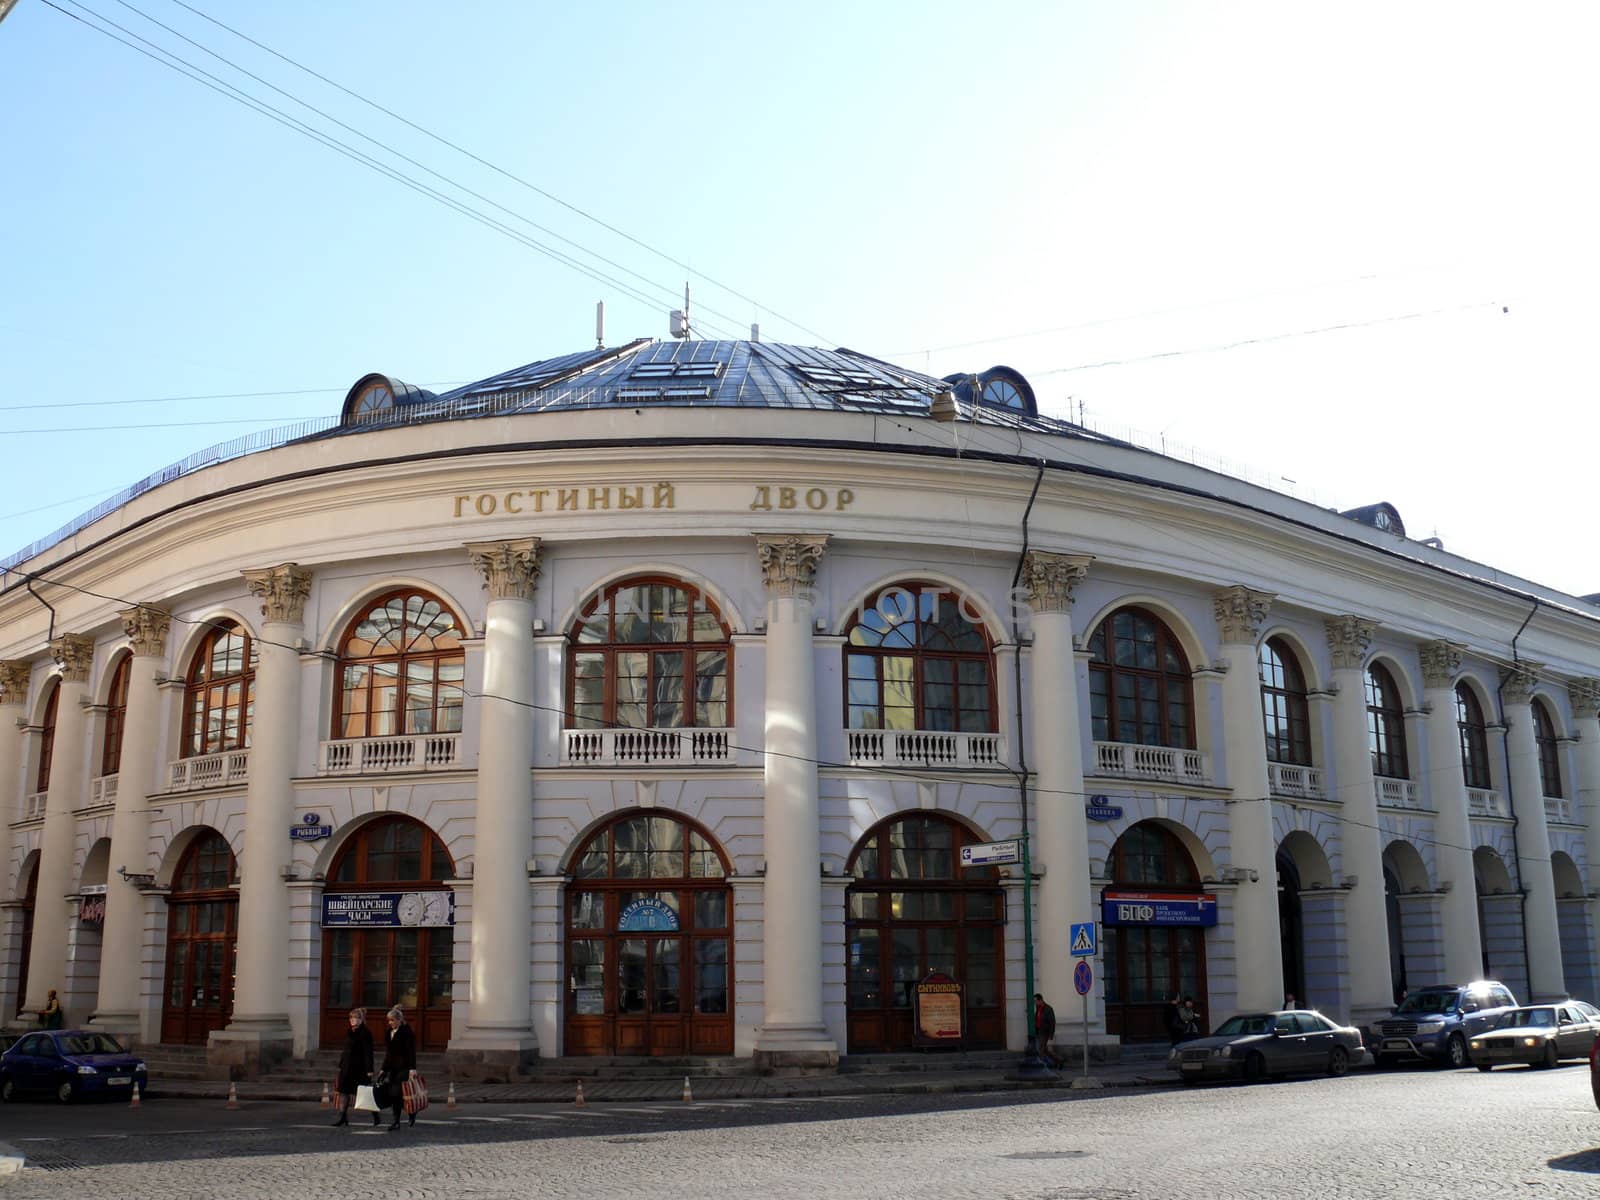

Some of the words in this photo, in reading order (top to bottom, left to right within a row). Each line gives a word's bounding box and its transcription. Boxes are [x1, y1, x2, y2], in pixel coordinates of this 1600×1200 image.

[452, 481, 676, 518] ГОСТИНЫЙ
[750, 486, 854, 511] ДВОР
[328, 899, 392, 910] ШВЕЙЦАРСКИЕ
[348, 911, 371, 921] ЧАСЫ
[1118, 904, 1154, 921] БПФ
